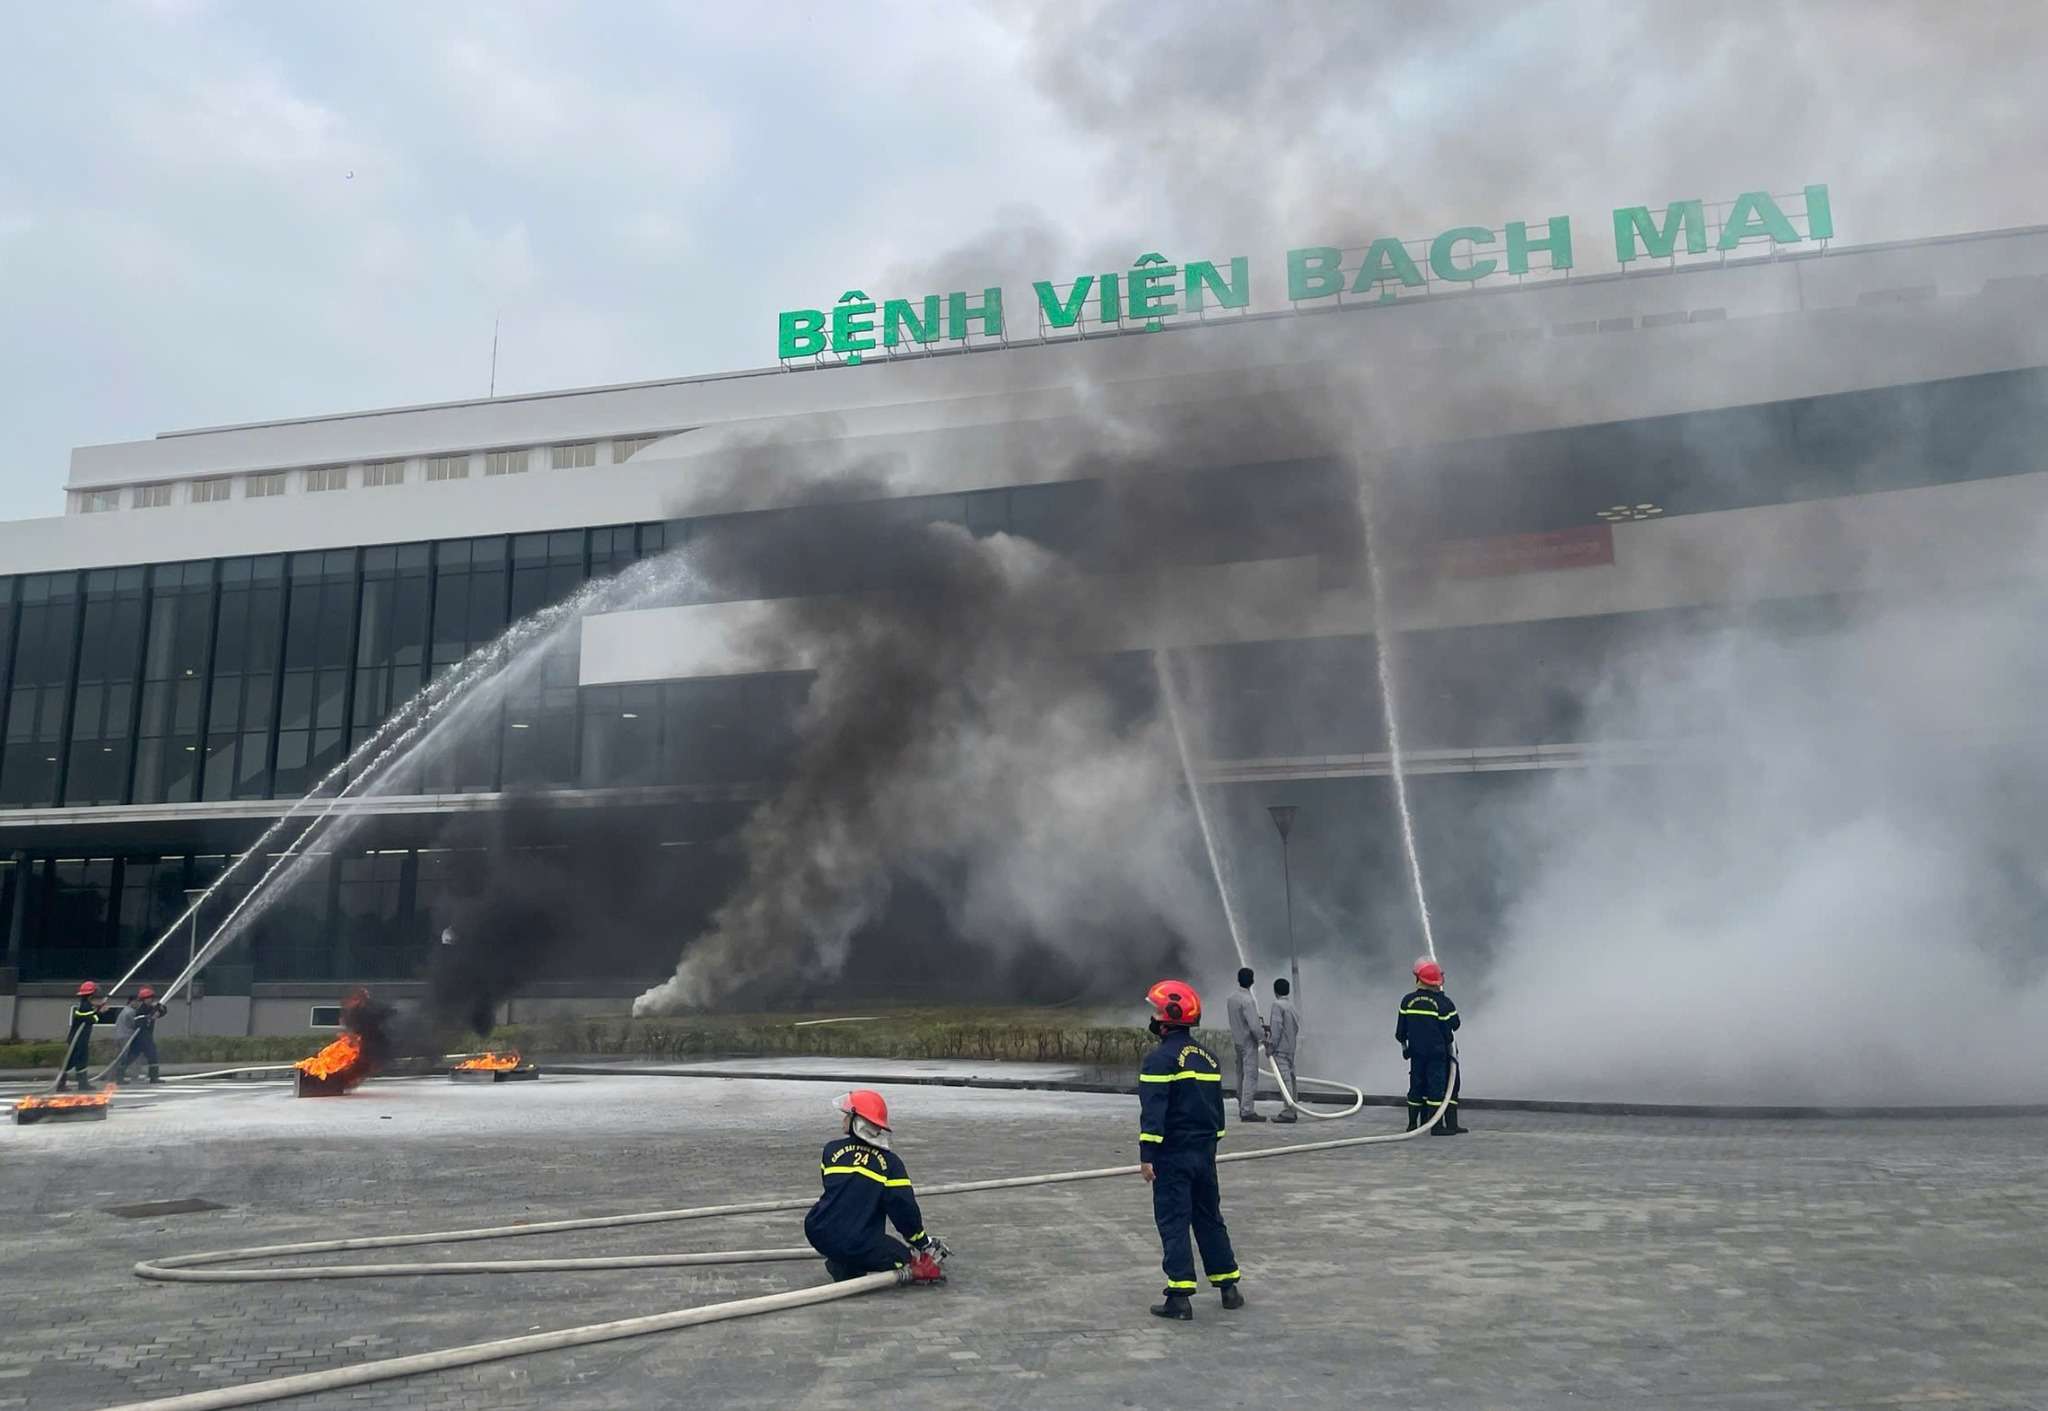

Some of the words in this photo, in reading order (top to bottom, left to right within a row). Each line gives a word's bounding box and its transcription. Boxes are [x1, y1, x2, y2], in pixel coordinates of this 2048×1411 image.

[778, 287, 1002, 365] BỆNH
[1032, 252, 1250, 333] VIỆN
[1286, 215, 1573, 304] BẠCH
[1612, 184, 1835, 263] MAI
[853, 1152, 870, 1166] 24
